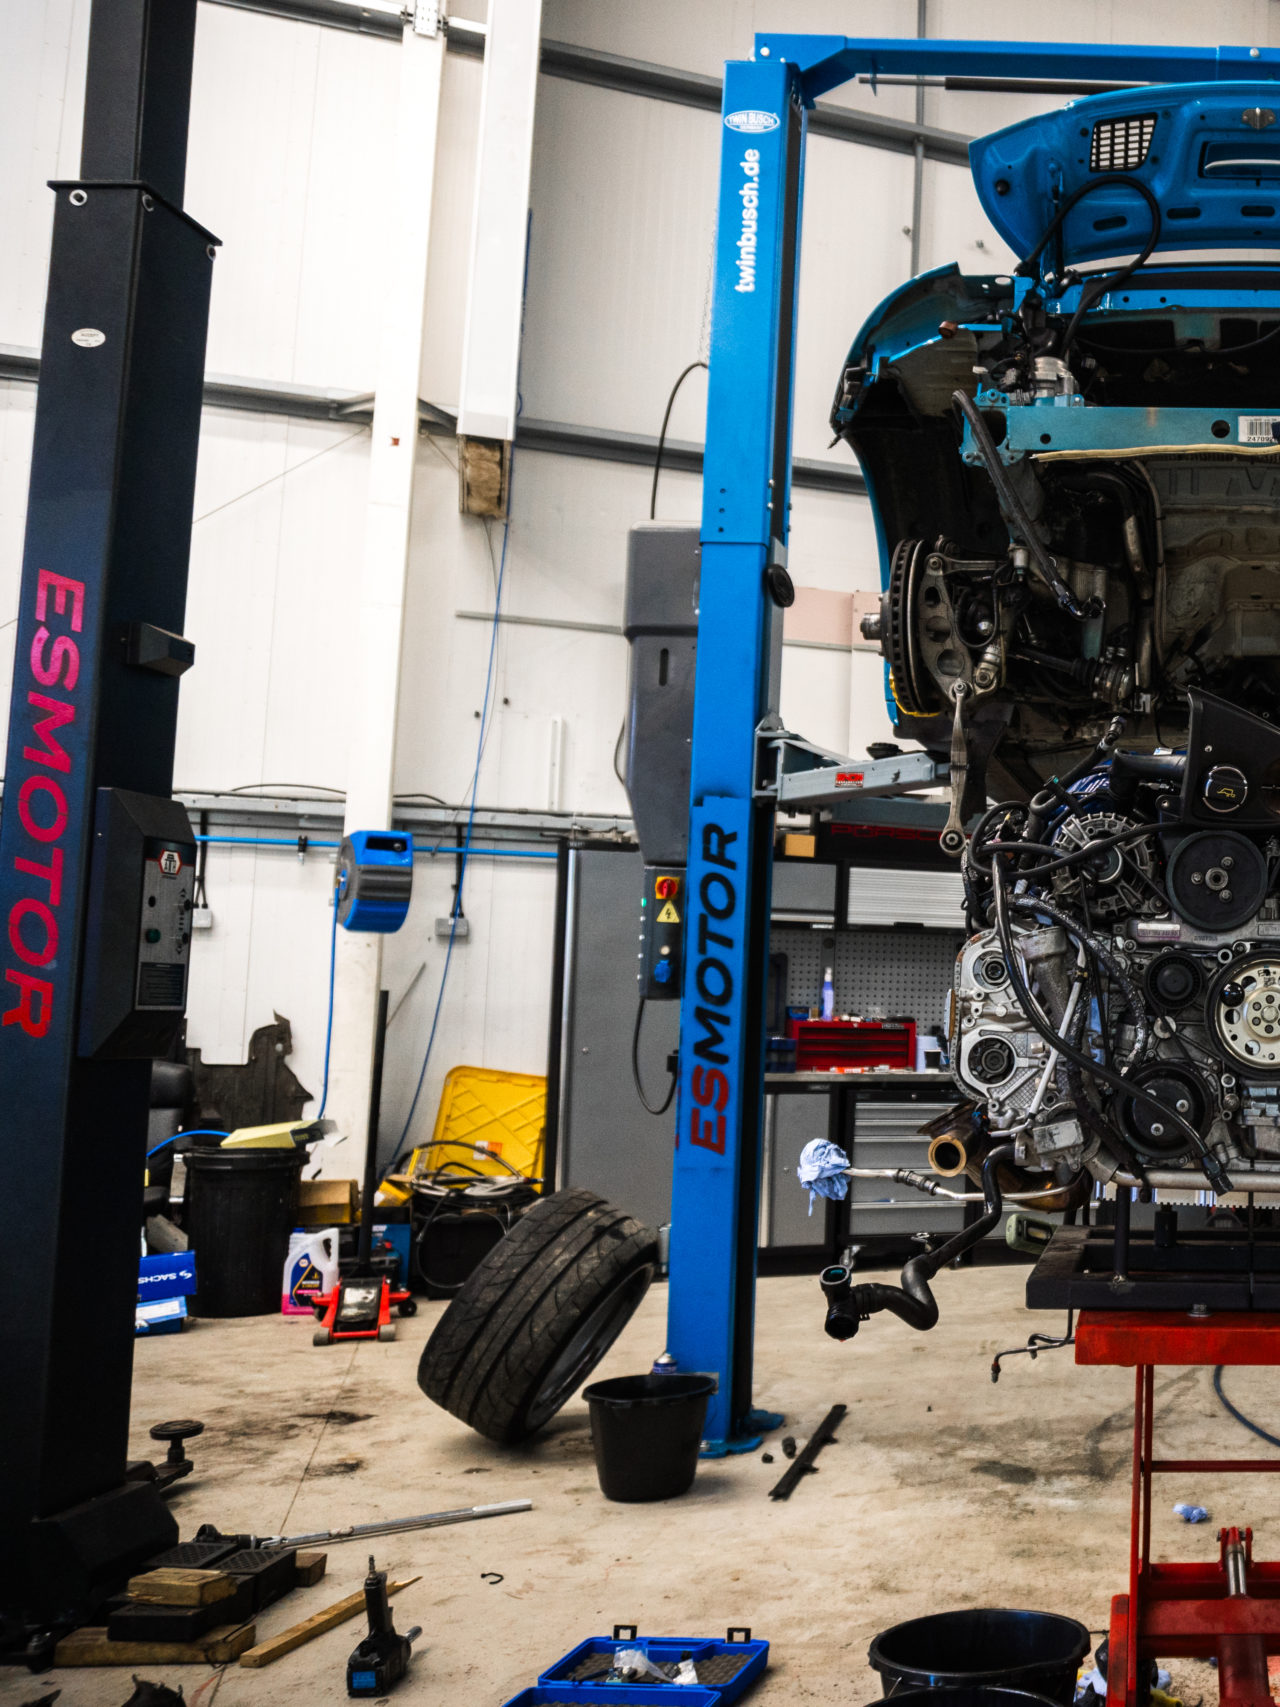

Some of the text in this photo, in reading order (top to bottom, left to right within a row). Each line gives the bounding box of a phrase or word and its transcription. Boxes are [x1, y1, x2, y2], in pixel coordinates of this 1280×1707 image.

[734, 148, 760, 293] twinbusch.de
[2, 568, 86, 1039] ESMOTOR
[690, 822, 738, 1156] ESMOTOR
[138, 1272, 177, 1284] SACHS
